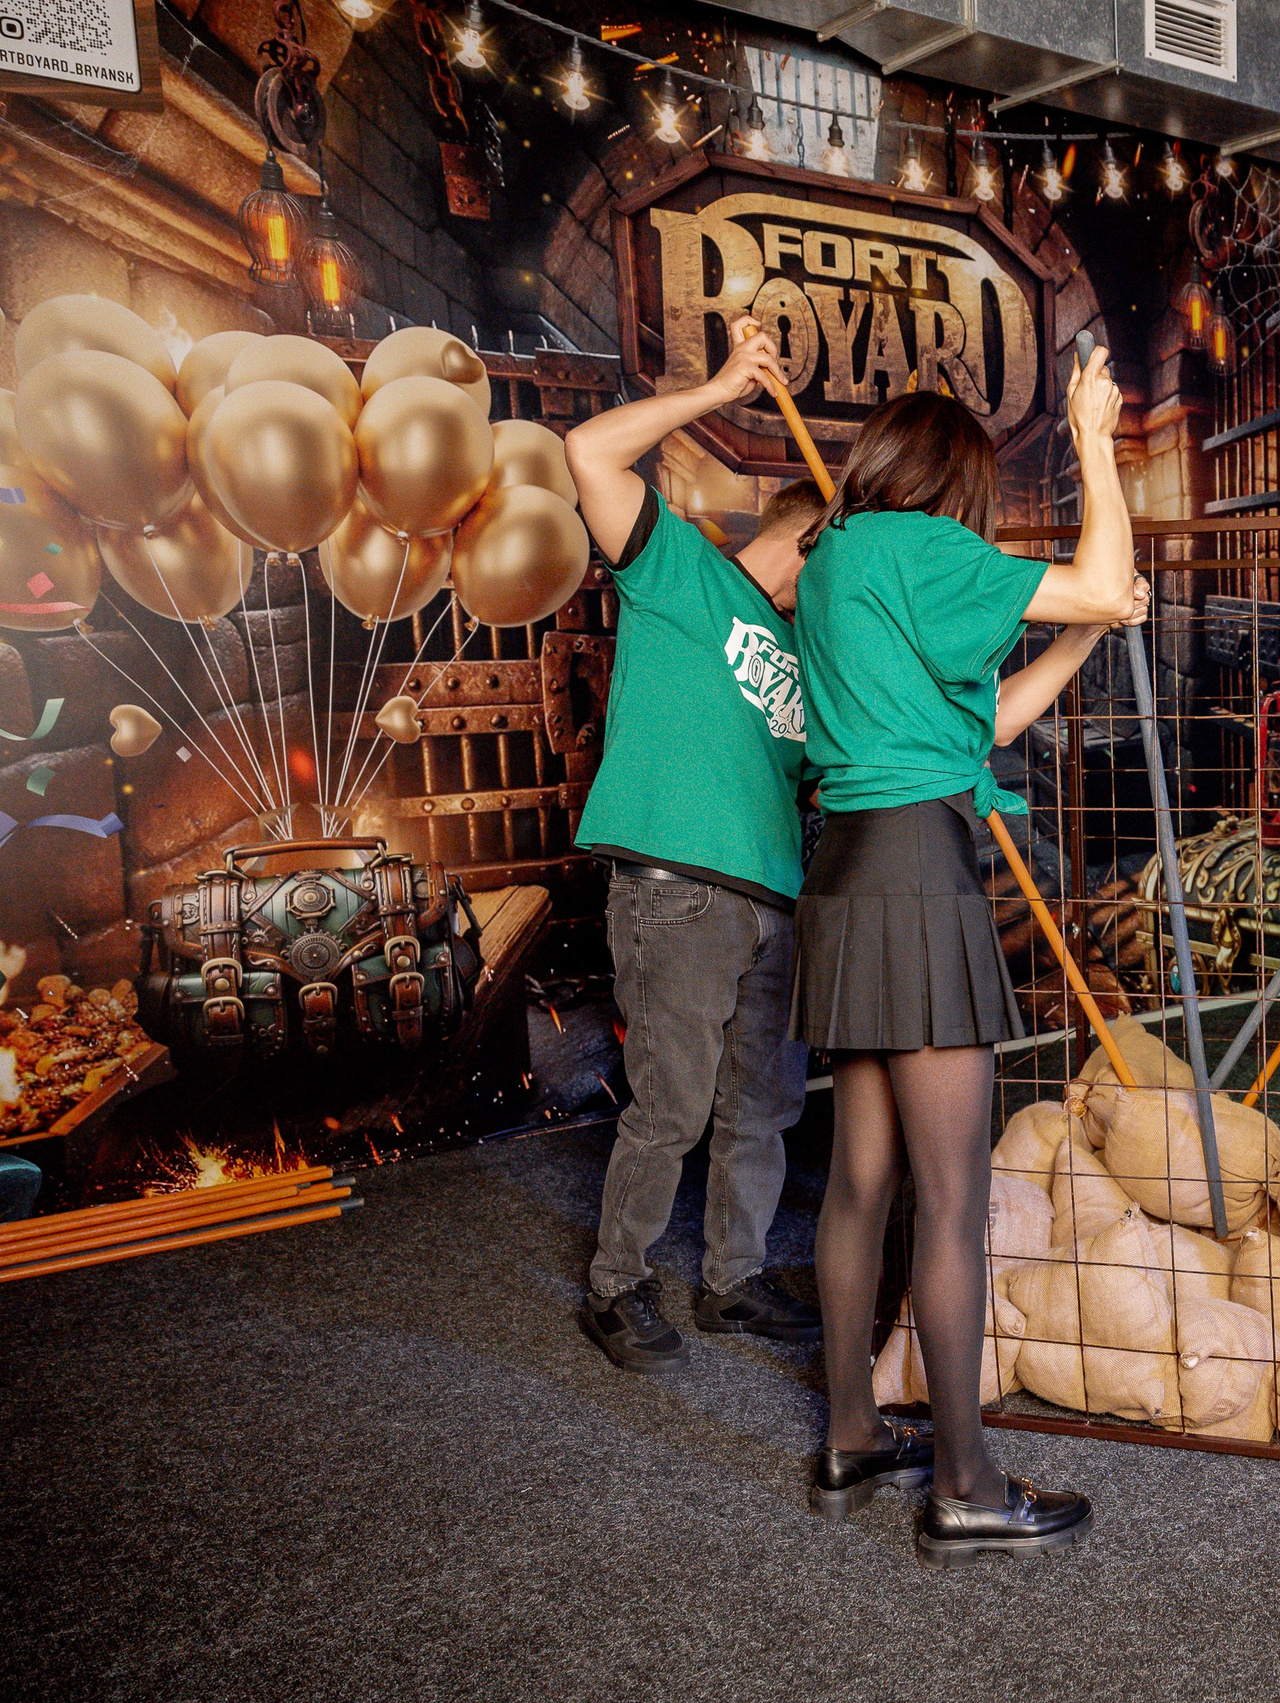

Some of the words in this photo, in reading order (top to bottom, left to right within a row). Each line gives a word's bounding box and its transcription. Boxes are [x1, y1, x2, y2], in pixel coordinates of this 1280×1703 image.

[649, 192, 1038, 441] BOYARD
[763, 223, 938, 290] FORT
[724, 616, 807, 743] BOYAR
